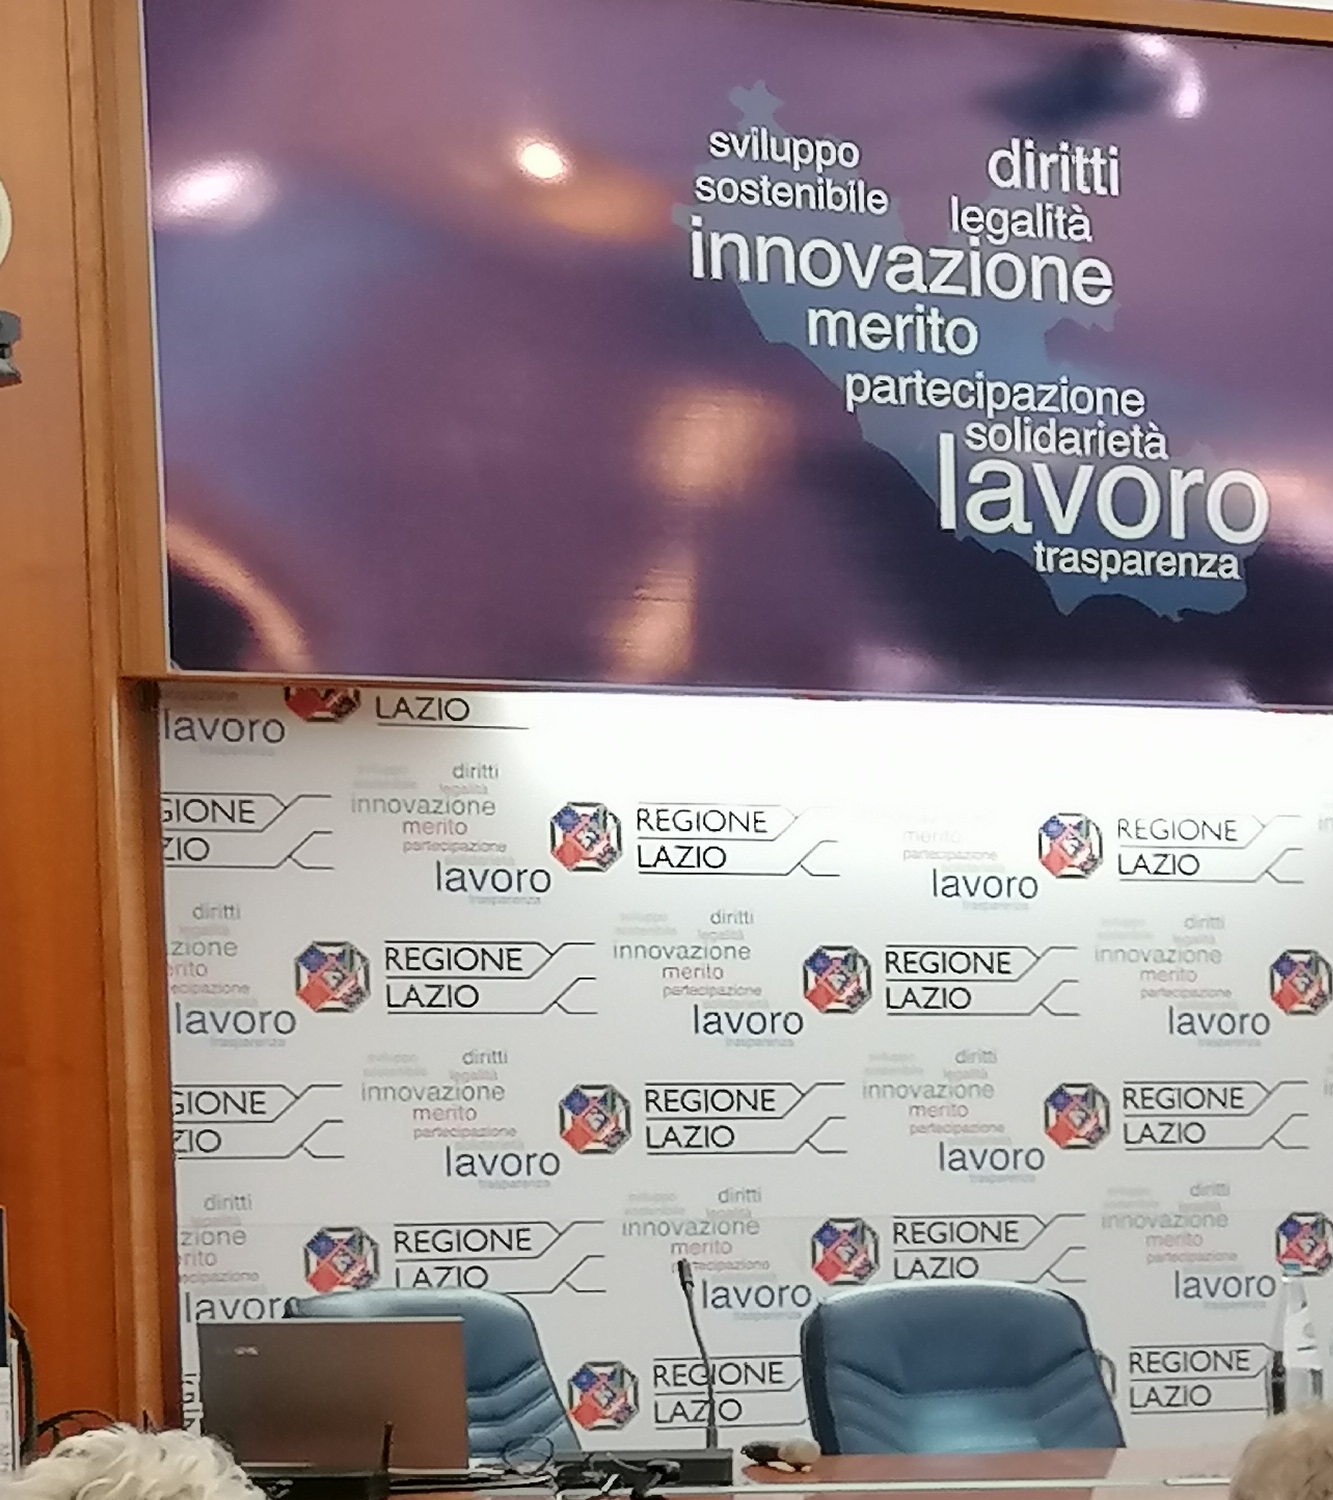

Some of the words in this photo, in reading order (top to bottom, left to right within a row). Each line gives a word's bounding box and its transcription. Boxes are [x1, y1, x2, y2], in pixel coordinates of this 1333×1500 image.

[709, 127, 860, 171] sviluppo
[987, 139, 1121, 196] diritti
[695, 173, 889, 215] sostenibile
[951, 196, 1093, 244] legalità
[690, 215, 1114, 306] innovazione
[807, 304, 978, 355] merito
[845, 370, 1145, 417] partecipazione
[964, 417, 1169, 461] solidarietà
[939, 432, 1269, 544] lavoro
[1033, 541, 1241, 582] trasparenza
[375, 696, 470, 721] LAZIO
[164, 709, 285, 743] lavoro
[351, 796, 496, 816] innovazione
[636, 807, 768, 834] REGIONE
[1117, 818, 1239, 842] REGIONE
[637, 845, 727, 869] LAZIO
[1118, 853, 1200, 877] LAZIO
[435, 859, 551, 893] lavoro
[932, 867, 1038, 900] lavoro
[384, 948, 523, 972] REGIONE
[613, 941, 752, 961] innovazione
[885, 951, 1012, 975] REGIONE
[1094, 946, 1223, 966] innovazione
[385, 984, 479, 1008] LAZIO
[886, 986, 972, 1010] LAZIO
[176, 1002, 297, 1036] lavoro
[693, 1003, 805, 1037] lavoro
[1168, 1004, 1272, 1036] lavoro
[361, 1082, 506, 1102] innovazione
[644, 1088, 777, 1114] REGIONE
[861, 1081, 996, 1100] innovazione
[1122, 1087, 1245, 1110] REGIONE
[646, 1125, 736, 1149] LAZIO
[1122, 1122, 1207, 1145] LAZIO
[445, 1145, 560, 1178] lavoro
[938, 1141, 1046, 1172] lavoro
[394, 1229, 532, 1253] REGIONE
[621, 1219, 760, 1237] innovazione
[893, 1221, 1019, 1244] REGIONE
[894, 1257, 978, 1279] LAZIO
[702, 1280, 812, 1309] lavoro
[1174, 1270, 1276, 1299] lavoro
[653, 1361, 783, 1387] REGIONE
[1130, 1349, 1251, 1373] REGIONE
[1130, 1384, 1212, 1408] LAZIO
[654, 1398, 743, 1424] LAZO
